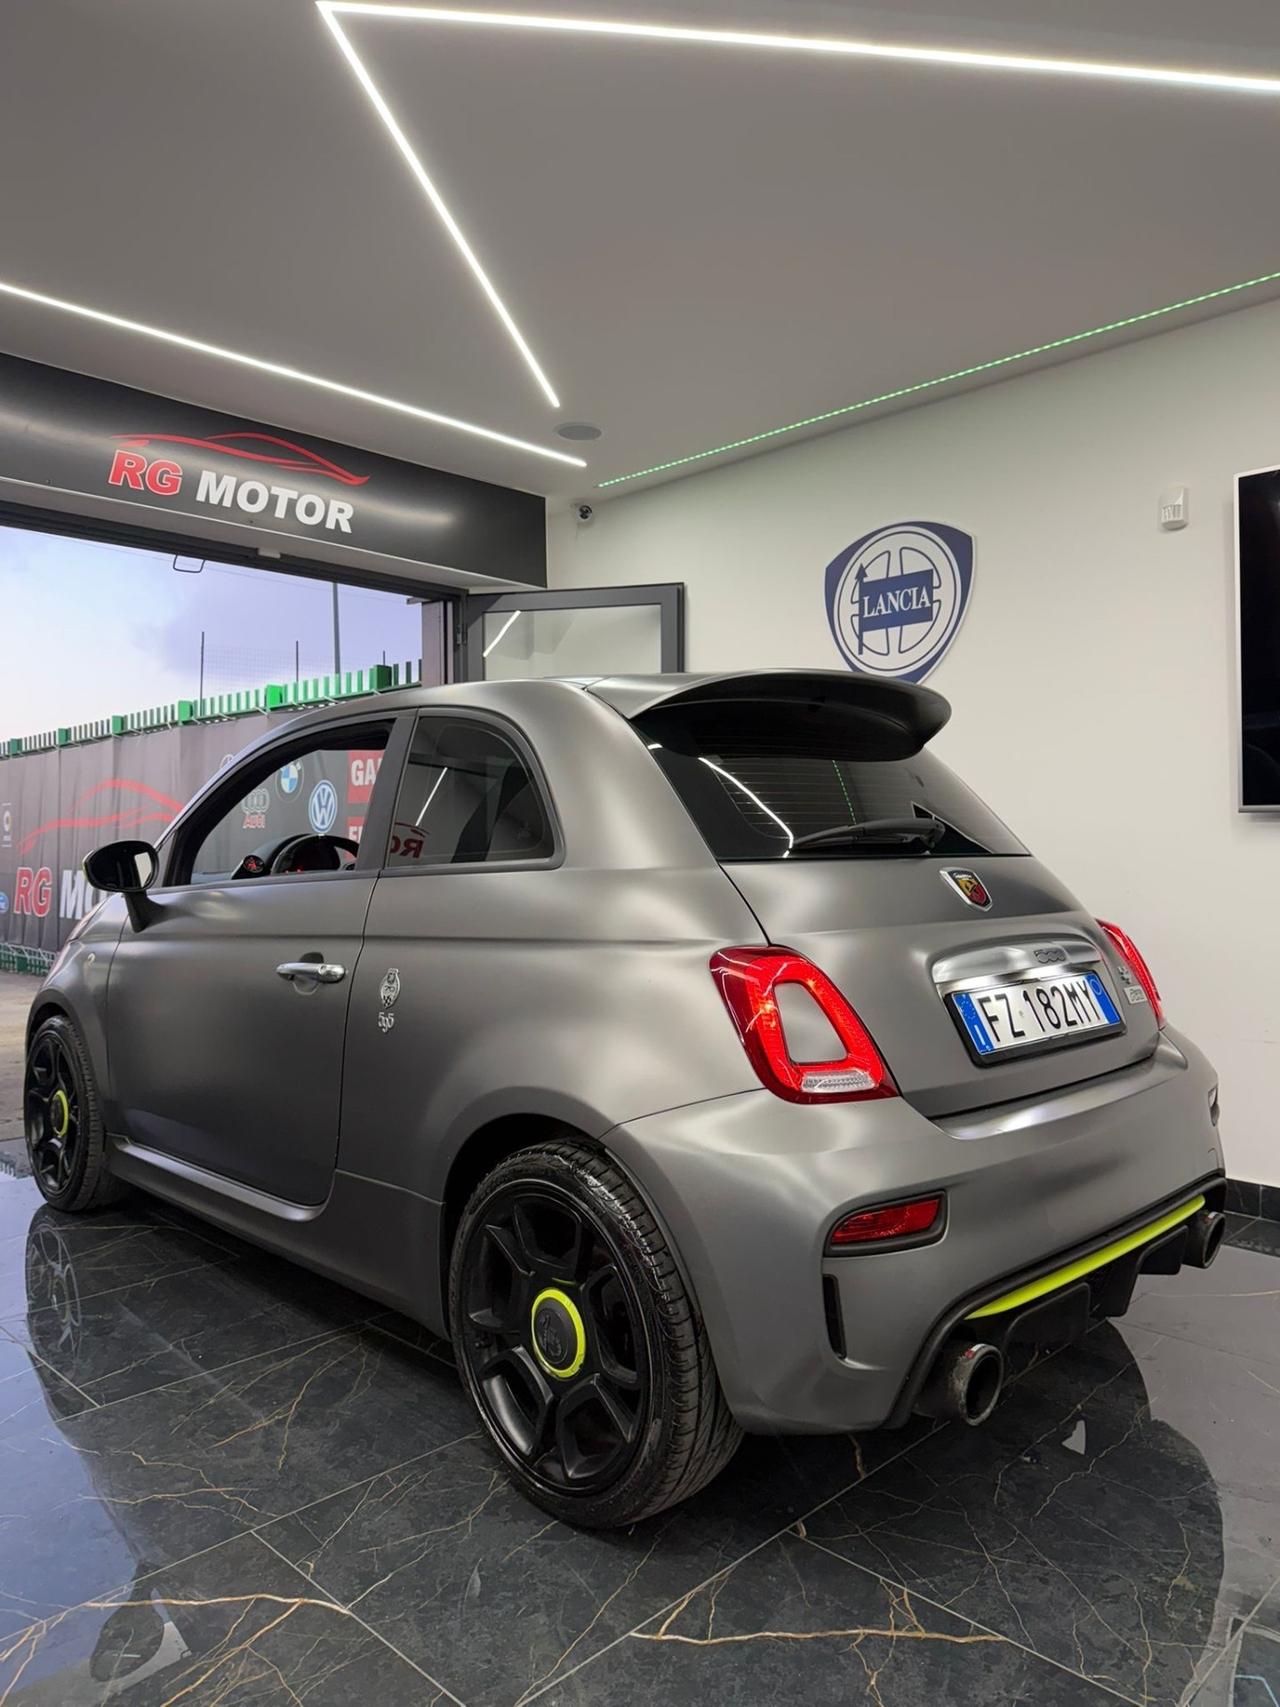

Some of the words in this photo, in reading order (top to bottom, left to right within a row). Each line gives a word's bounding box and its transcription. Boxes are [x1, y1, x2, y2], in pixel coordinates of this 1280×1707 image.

[108, 449, 183, 496] RG
[196, 470, 354, 533] MOTOR
[862, 585, 931, 618] LANCIA
[351, 757, 383, 787] GA
[14, 866, 52, 917] RG
[977, 993, 1025, 1043] FZ
[1022, 980, 1101, 1032] 182MY
